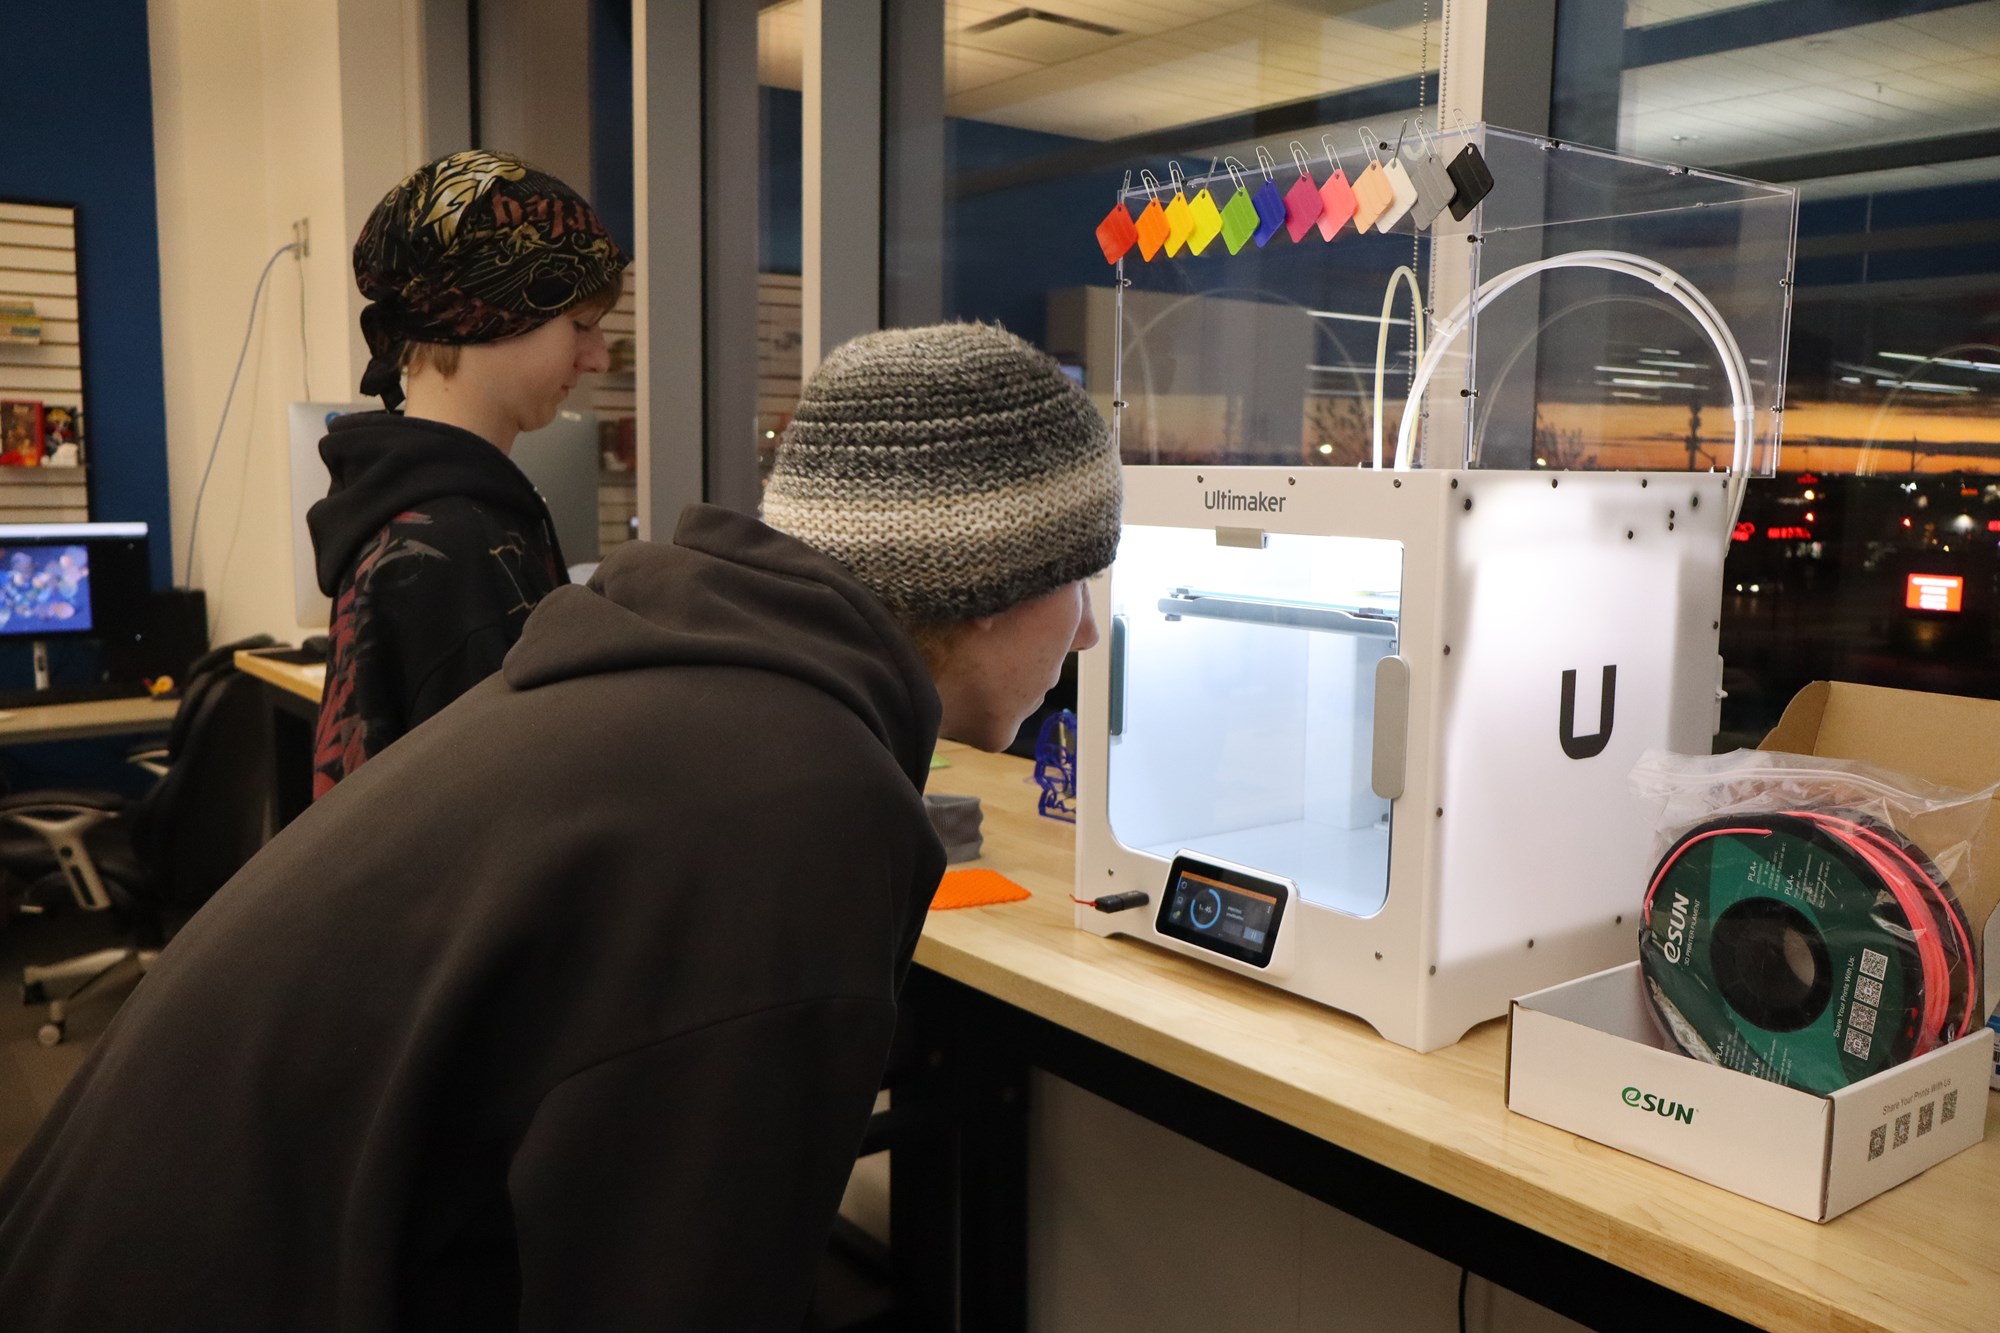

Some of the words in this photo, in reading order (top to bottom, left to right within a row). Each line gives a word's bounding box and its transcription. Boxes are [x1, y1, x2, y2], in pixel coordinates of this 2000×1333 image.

[1204, 489, 1287, 513] Ultimaker
[1558, 663, 1617, 760] U
[1747, 860, 1758, 883] PLA+
[1784, 874, 1795, 896] PLA+
[1690, 898, 1701, 930] FILAMENT
[1663, 892, 1690, 964] eSUN
[1685, 929, 1696, 957] PRINTER
[1843, 967, 1853, 982] With
[1839, 982, 1850, 1002] Prints
[1836, 1002, 1846, 1018] Your
[1832, 1018, 1843, 1038] Share
[1621, 1086, 1694, 1125] eSUN
[1882, 1102, 1900, 1116] Share
[1900, 1095, 1913, 1107] Your
[1913, 1088, 1930, 1101] Prints
